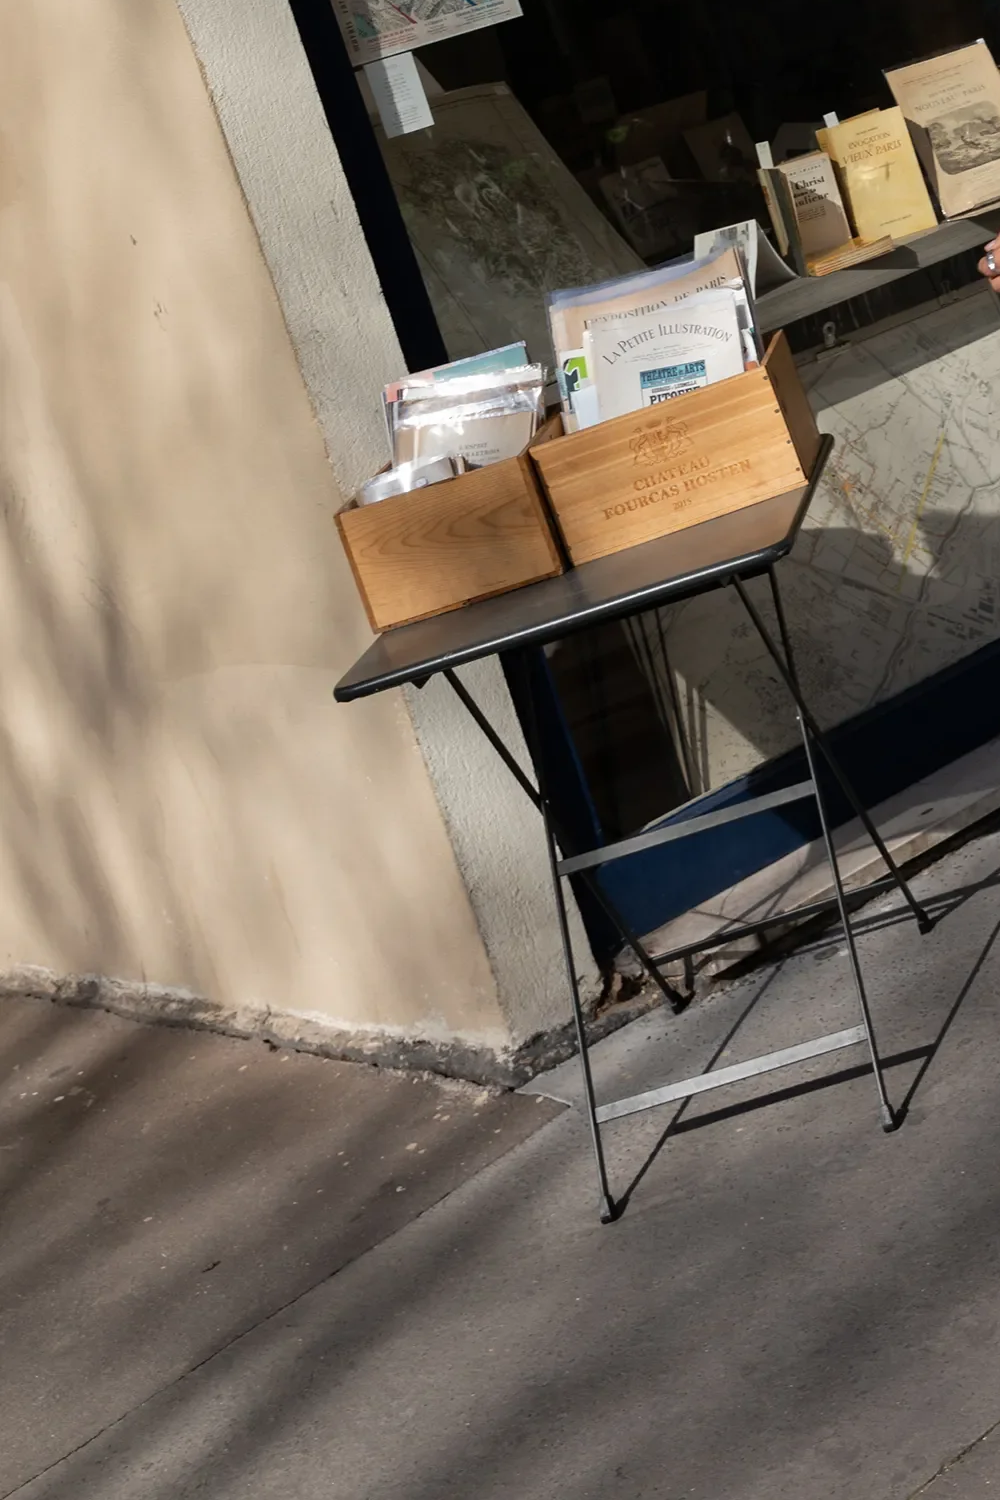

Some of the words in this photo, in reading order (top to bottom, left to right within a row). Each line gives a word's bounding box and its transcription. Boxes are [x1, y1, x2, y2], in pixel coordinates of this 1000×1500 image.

[795, 176, 825, 190] Christ
[602, 352, 621, 365] LA
[617, 325, 656, 353] PETITE
[658, 322, 733, 343] ILLUSTRATION
[684, 360, 706, 374] ARTS
[602, 483, 680, 520] FOURCAS
[683, 458, 751, 493] HOSTEN
